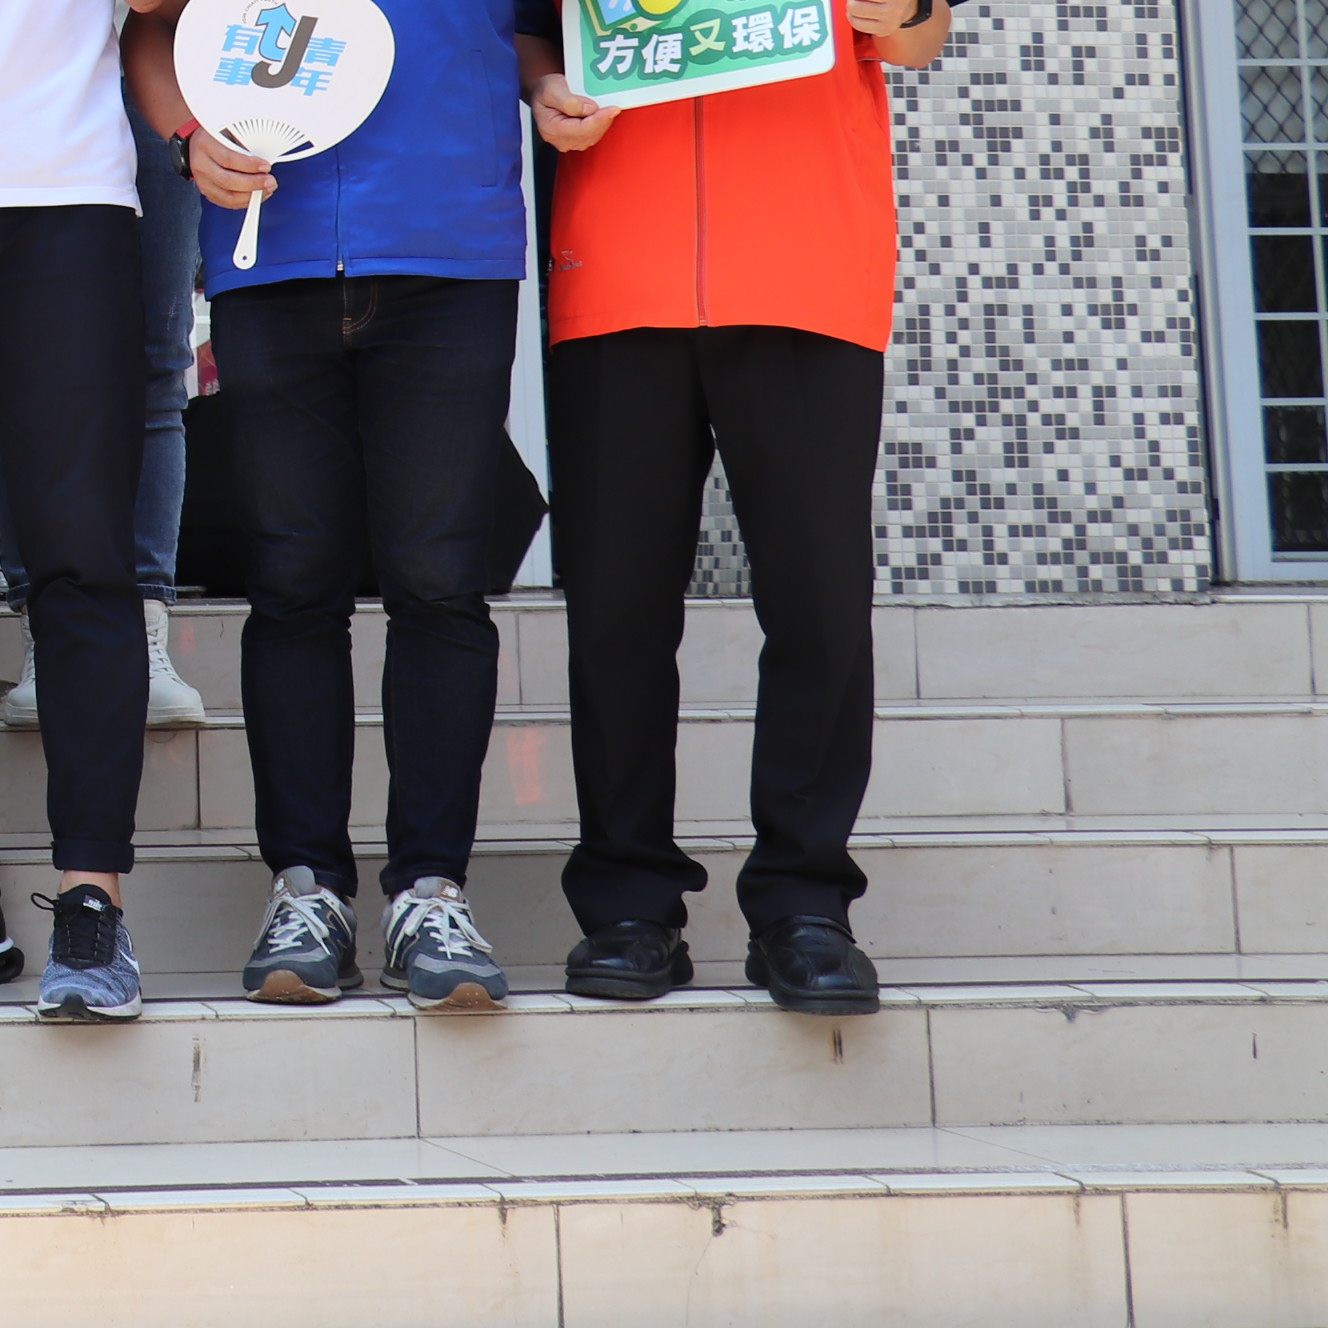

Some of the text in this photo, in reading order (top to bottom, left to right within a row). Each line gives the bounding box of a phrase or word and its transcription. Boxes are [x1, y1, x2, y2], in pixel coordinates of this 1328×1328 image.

[596, 5, 822, 75] 方便又環保
